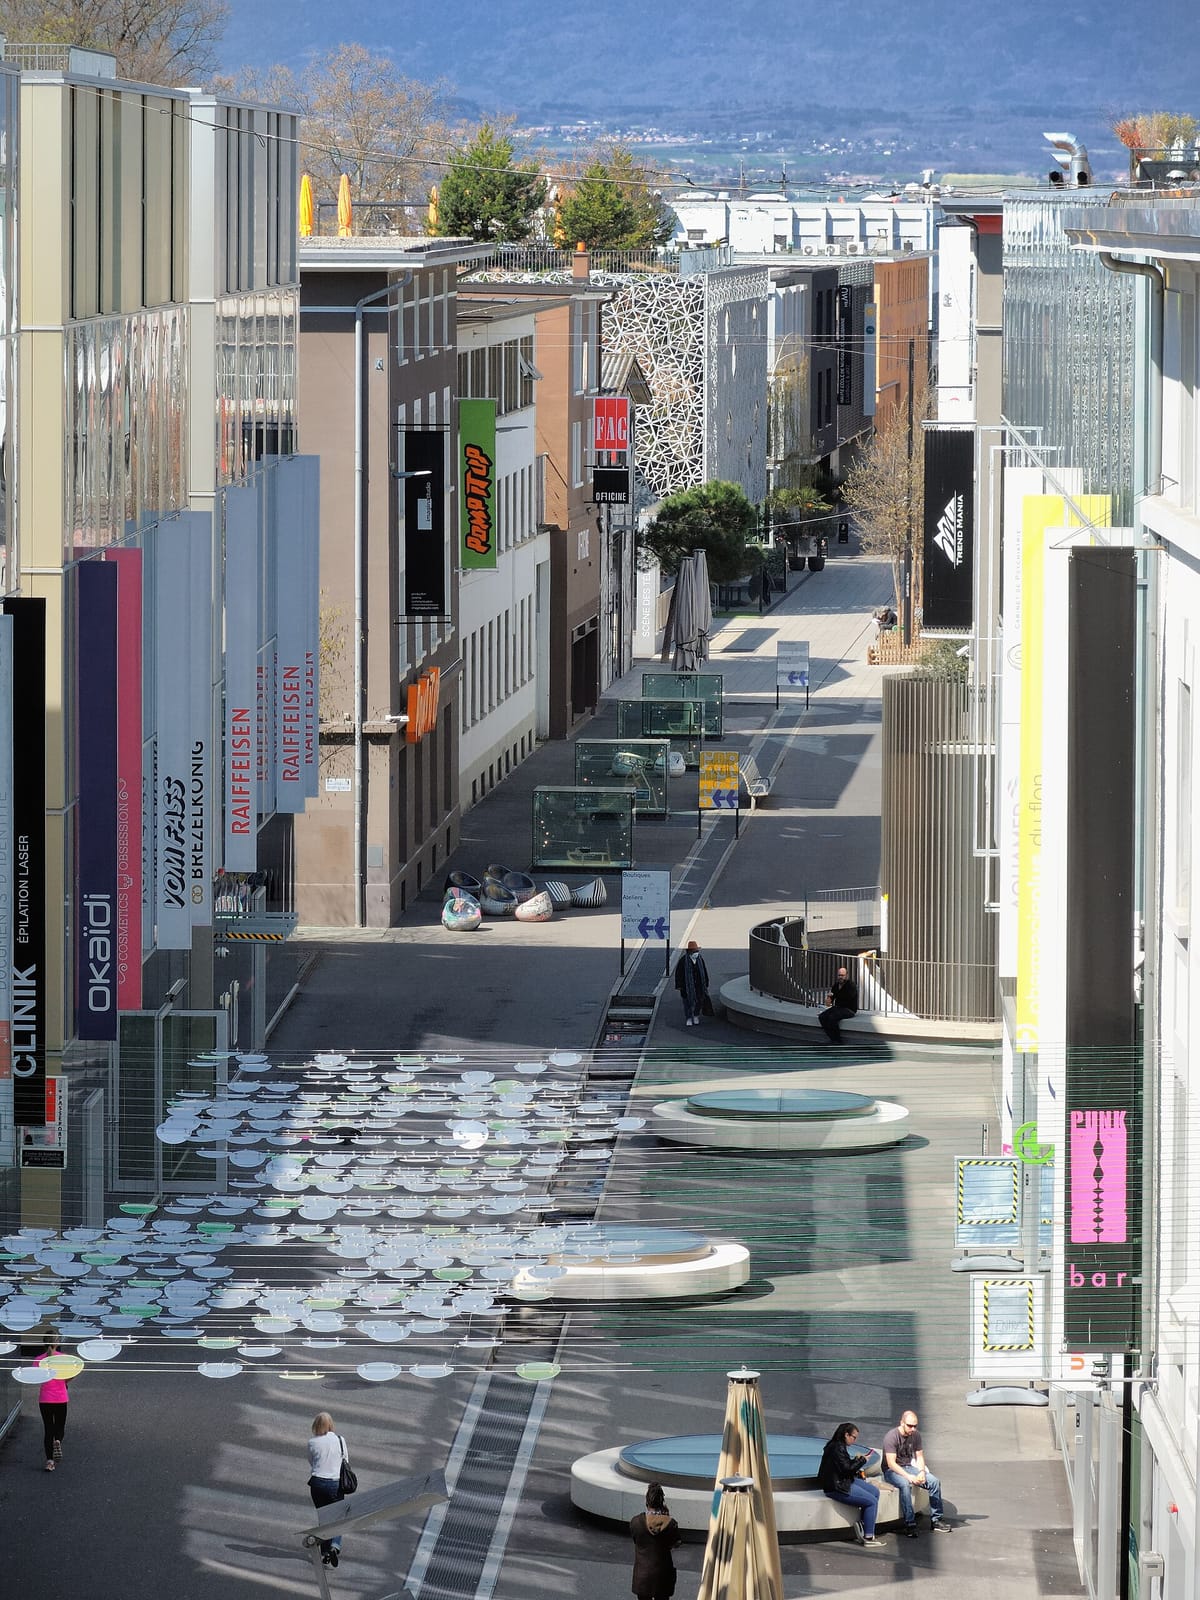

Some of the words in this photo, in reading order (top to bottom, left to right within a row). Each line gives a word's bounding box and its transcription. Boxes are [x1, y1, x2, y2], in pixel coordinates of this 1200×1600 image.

[596, 416, 628, 441] FAG
[465, 444, 491, 478] UP
[466, 470, 491, 498] IT
[465, 497, 491, 554] POMP
[956, 494, 964, 528] MANIA
[956, 529, 964, 565] TREND
[282, 666, 300, 782] RAIFFEISEN
[231, 708, 251, 834] RAIFFEISEN
[118, 803, 129, 870] OBSESSION
[162, 775, 186, 849] FASS
[18, 835, 29, 876] LASER
[162, 849, 186, 909] VOM
[622, 871, 651, 880] Boutiques
[16, 879, 29, 944] ÉPILATION
[118, 893, 129, 961] COSMETICS
[83, 893, 111, 1012] okaïdi
[12, 963, 36, 1078] CLINIK
[1070, 1110, 1127, 1129] PUNK
[1069, 1264, 1127, 1287] bar
